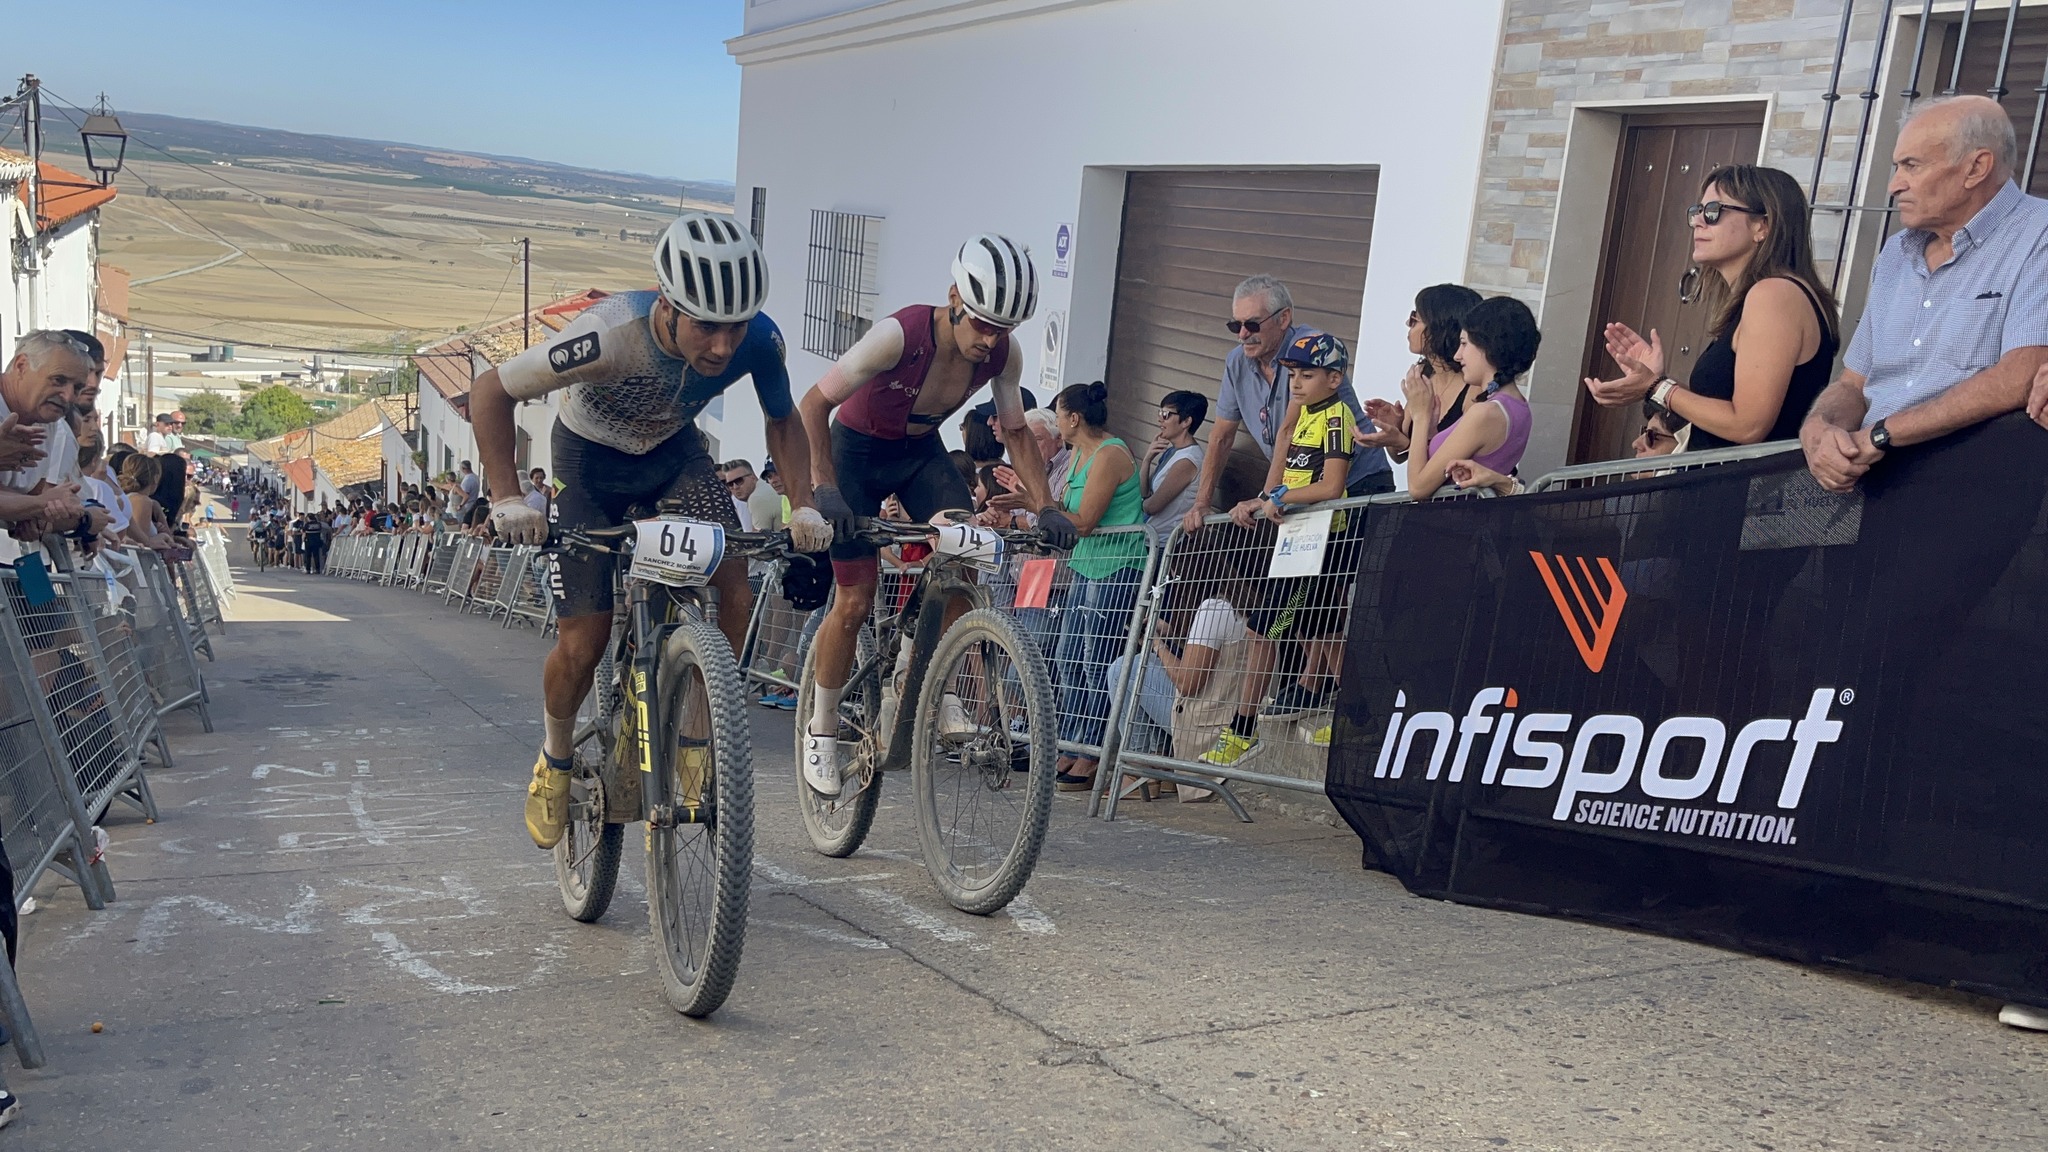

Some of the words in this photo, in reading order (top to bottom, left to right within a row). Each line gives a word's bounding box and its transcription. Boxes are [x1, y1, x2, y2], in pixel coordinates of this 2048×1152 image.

[572, 339, 593, 362] SP
[659, 523, 698, 562] 64
[1373, 686, 1844, 821] infisport
[1574, 798, 1663, 831] SCIENCE
[1664, 810, 1798, 845] NUTRITION.
